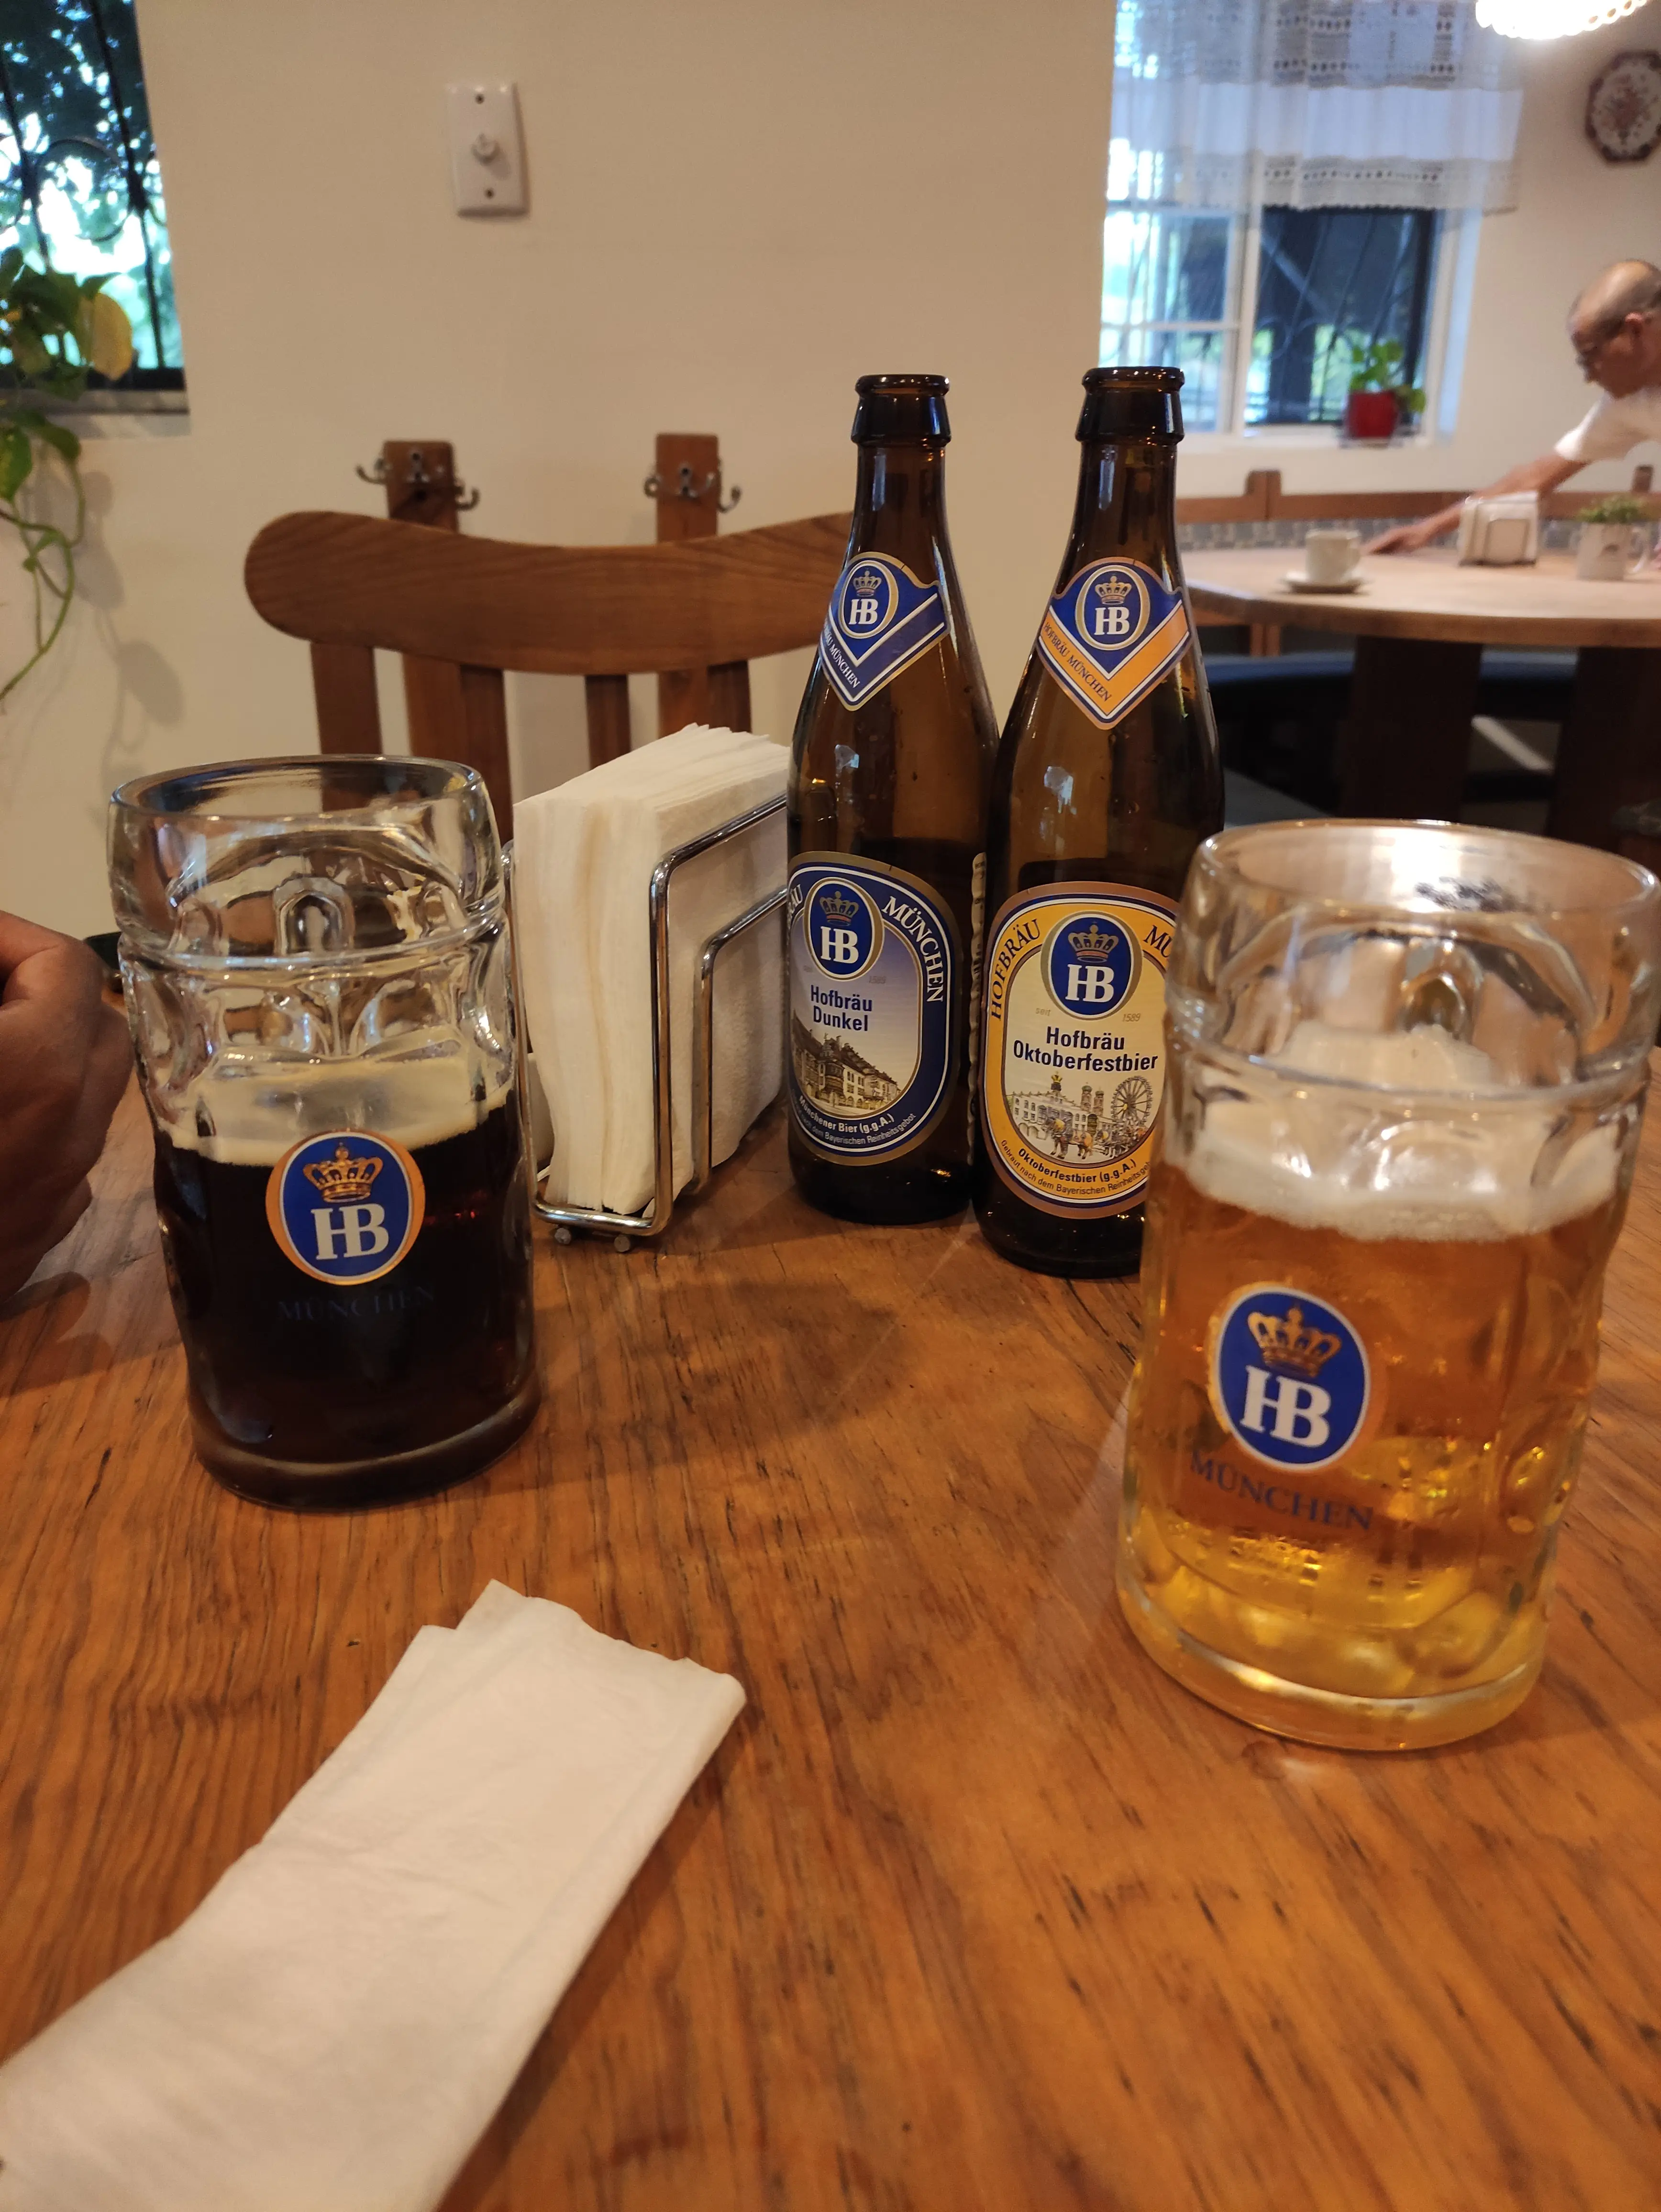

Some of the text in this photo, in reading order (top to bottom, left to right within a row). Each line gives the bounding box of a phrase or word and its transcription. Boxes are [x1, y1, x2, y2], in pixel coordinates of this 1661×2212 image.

[849, 599, 878, 625] HB
[1094, 607, 1130, 637] HB
[829, 644, 861, 688] MÜNCHEN
[1044, 622, 1112, 702] HOFBRÄU MÜNCHEN
[820, 926, 859, 964] HB
[881, 896, 944, 1002] MÜNCHEN
[991, 918, 1041, 1021] HOFBRÄU
[1065, 963, 1115, 1003] HB
[810, 984, 873, 1012] Hofbräu
[1035, 1006, 1141, 1023] seit 1589
[813, 1009, 868, 1031] Dunkel
[1046, 1026, 1125, 1051] Hofbräu
[1013, 1040, 1158, 1073] Oktoberfestbier
[824, 1131, 866, 1145] Bayerischen
[867, 1113, 917, 1143] Reinheitsgebot
[838, 1122, 858, 1133] Bier
[859, 1113, 895, 1134] (g.g.A.)
[1001, 1139, 1020, 1169] Gebraut
[1019, 1166, 1036, 1182] nach
[1038, 1178, 1054, 1190] dem
[1056, 1184, 1106, 1195] Bayerischen
[1018, 1148, 1137, 1183] Oktoberfestbier (g.g.A.)
[310, 1203, 389, 1261] HB
[1239, 1364, 1332, 1448] HB
